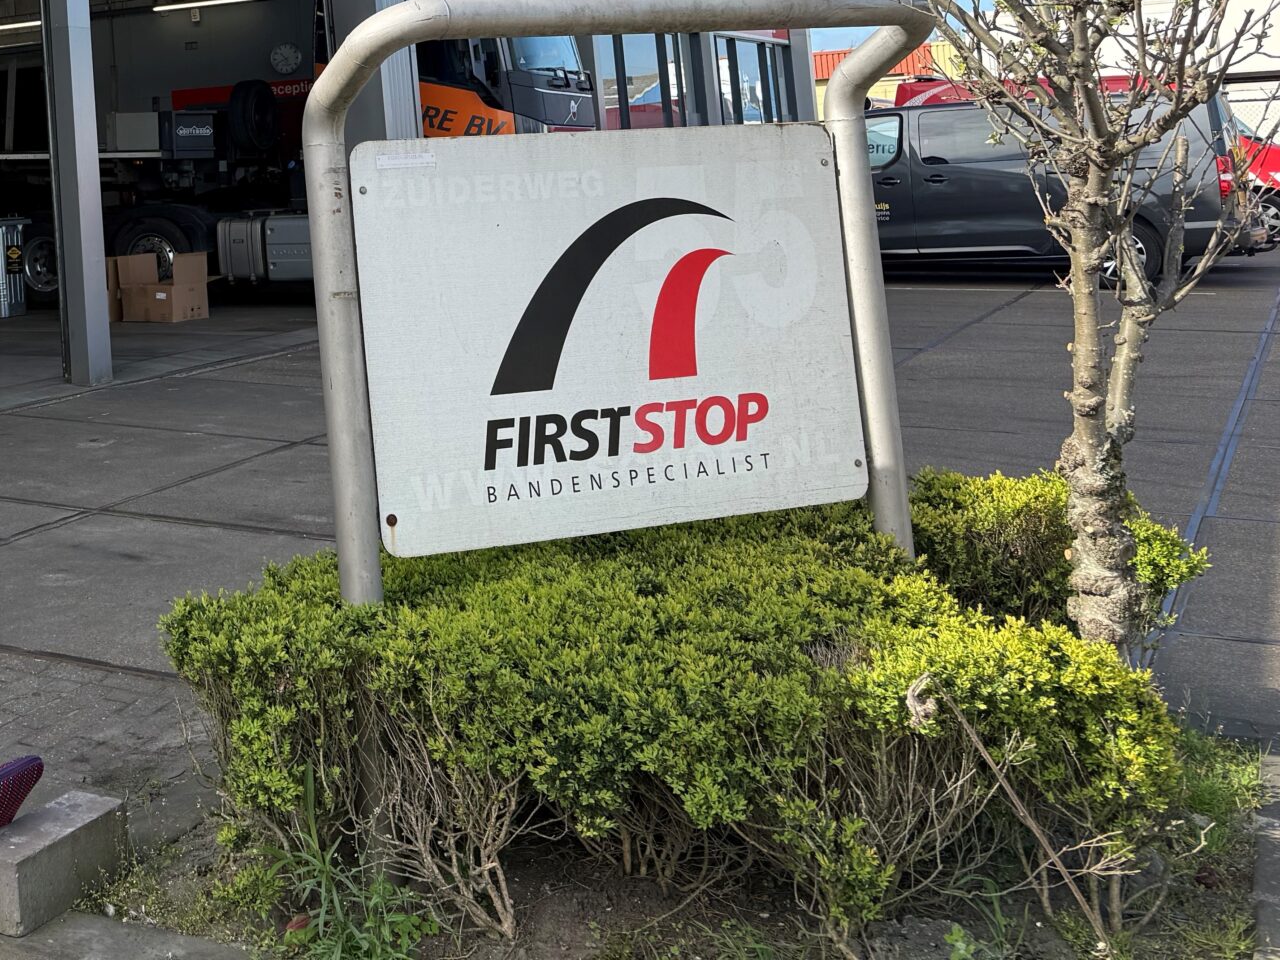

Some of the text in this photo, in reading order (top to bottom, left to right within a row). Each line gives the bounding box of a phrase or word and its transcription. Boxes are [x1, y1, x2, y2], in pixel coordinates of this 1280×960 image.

[422, 105, 458, 132] RE
[483, 392, 770, 471] FIRSTSTOP
[486, 452, 772, 504] BANDENSPECIALIST
